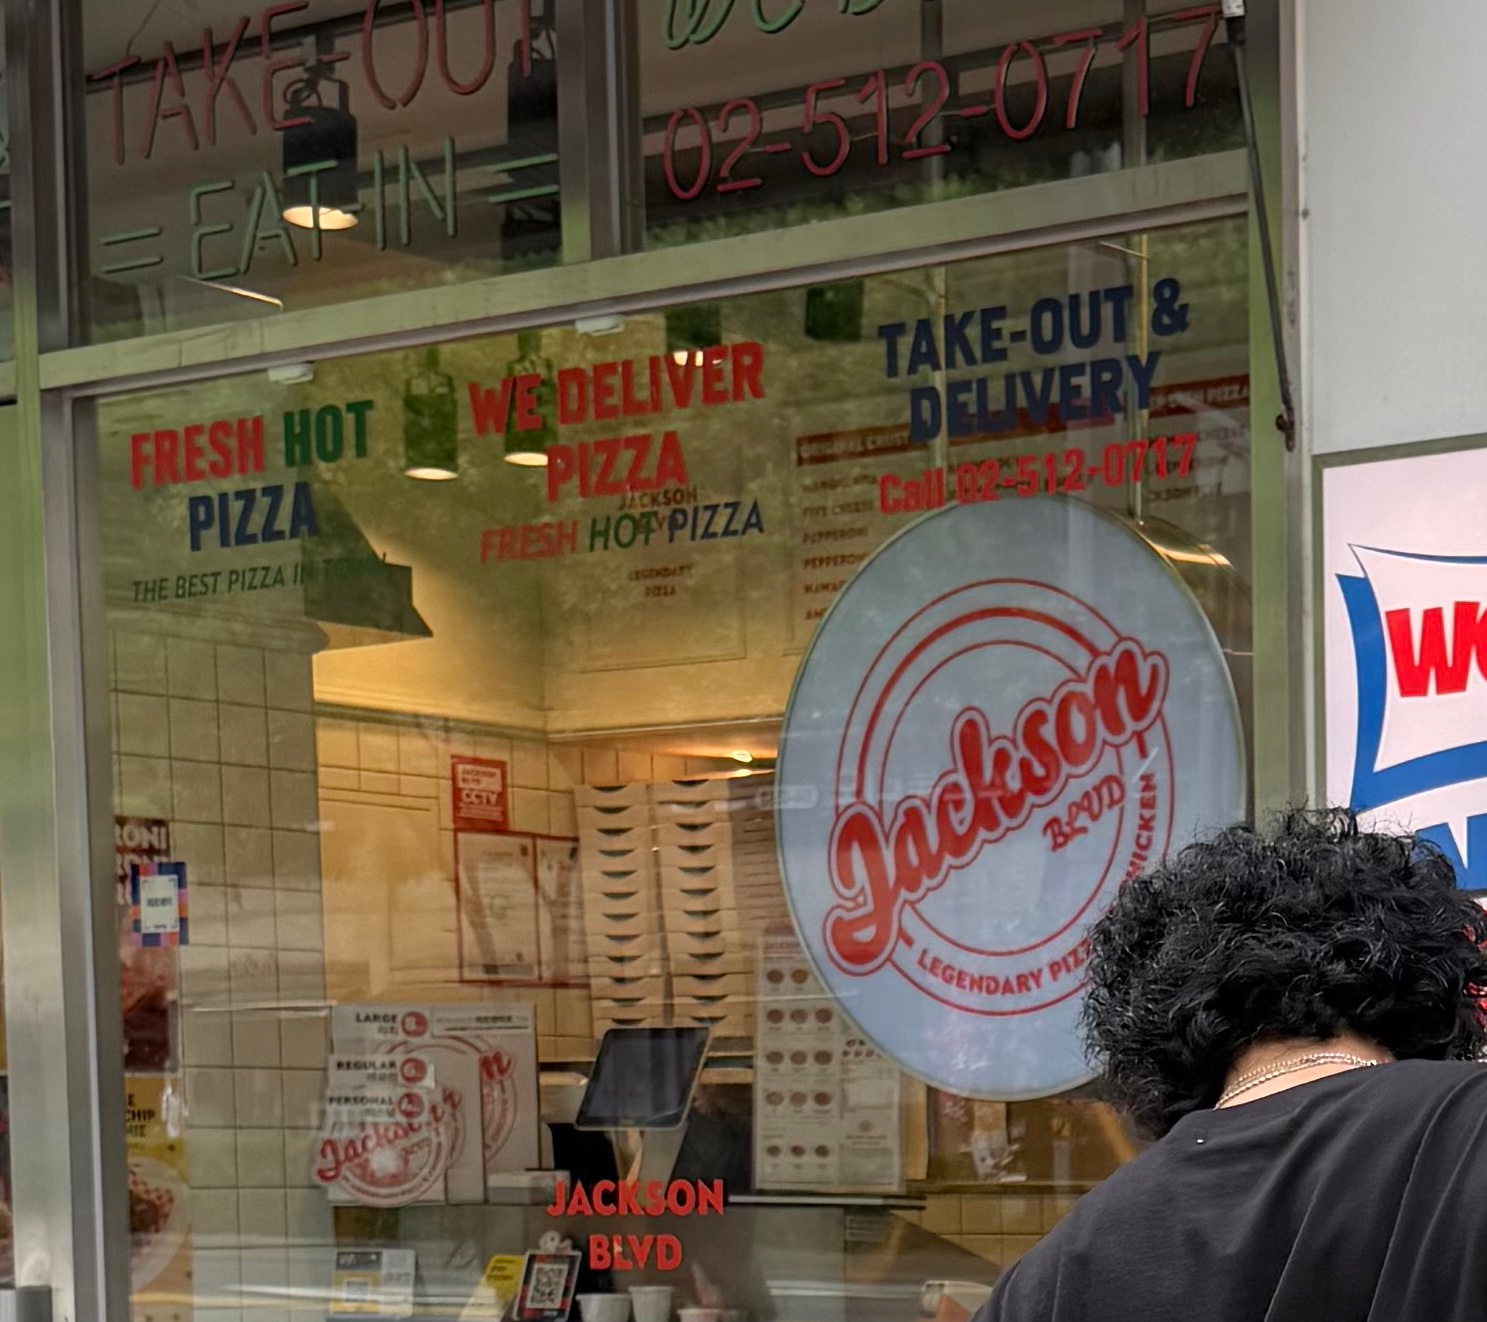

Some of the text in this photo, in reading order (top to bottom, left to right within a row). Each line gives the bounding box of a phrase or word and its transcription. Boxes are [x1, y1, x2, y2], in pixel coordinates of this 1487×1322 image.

[663, 6, 1224, 200] 02-512-0717
[878, 277, 1190, 379] TAKE-OUT &
[467, 341, 766, 436] WE DELIVER
[909, 351, 1161, 443] DELIVERY
[129, 400, 375, 490] FRESH HOT
[545, 429, 690, 502] PIZZA
[878, 432, 1199, 516] Call 02-512-0717
[188, 482, 320, 552] PIZZA
[479, 520, 579, 565] FRESH
[589, 511, 659, 552] HOT
[668, 499, 765, 543] PIZZA
[132, 578, 169, 602] THE
[174, 572, 222, 599] BEST
[227, 565, 286, 593] PIZZA
[293, 562, 312, 586] IN
[827, 640, 1166, 973] Jackson
[1119, 772, 1157, 895] HICKEN
[917, 935, 1092, 996] LEGENDARY PIZZ
[355, 1013, 398, 1024] LARGE
[336, 1060, 397, 1071] REGULAR
[547, 1179, 726, 1217] JACKSON
[588, 1235, 684, 1272] BLVD
